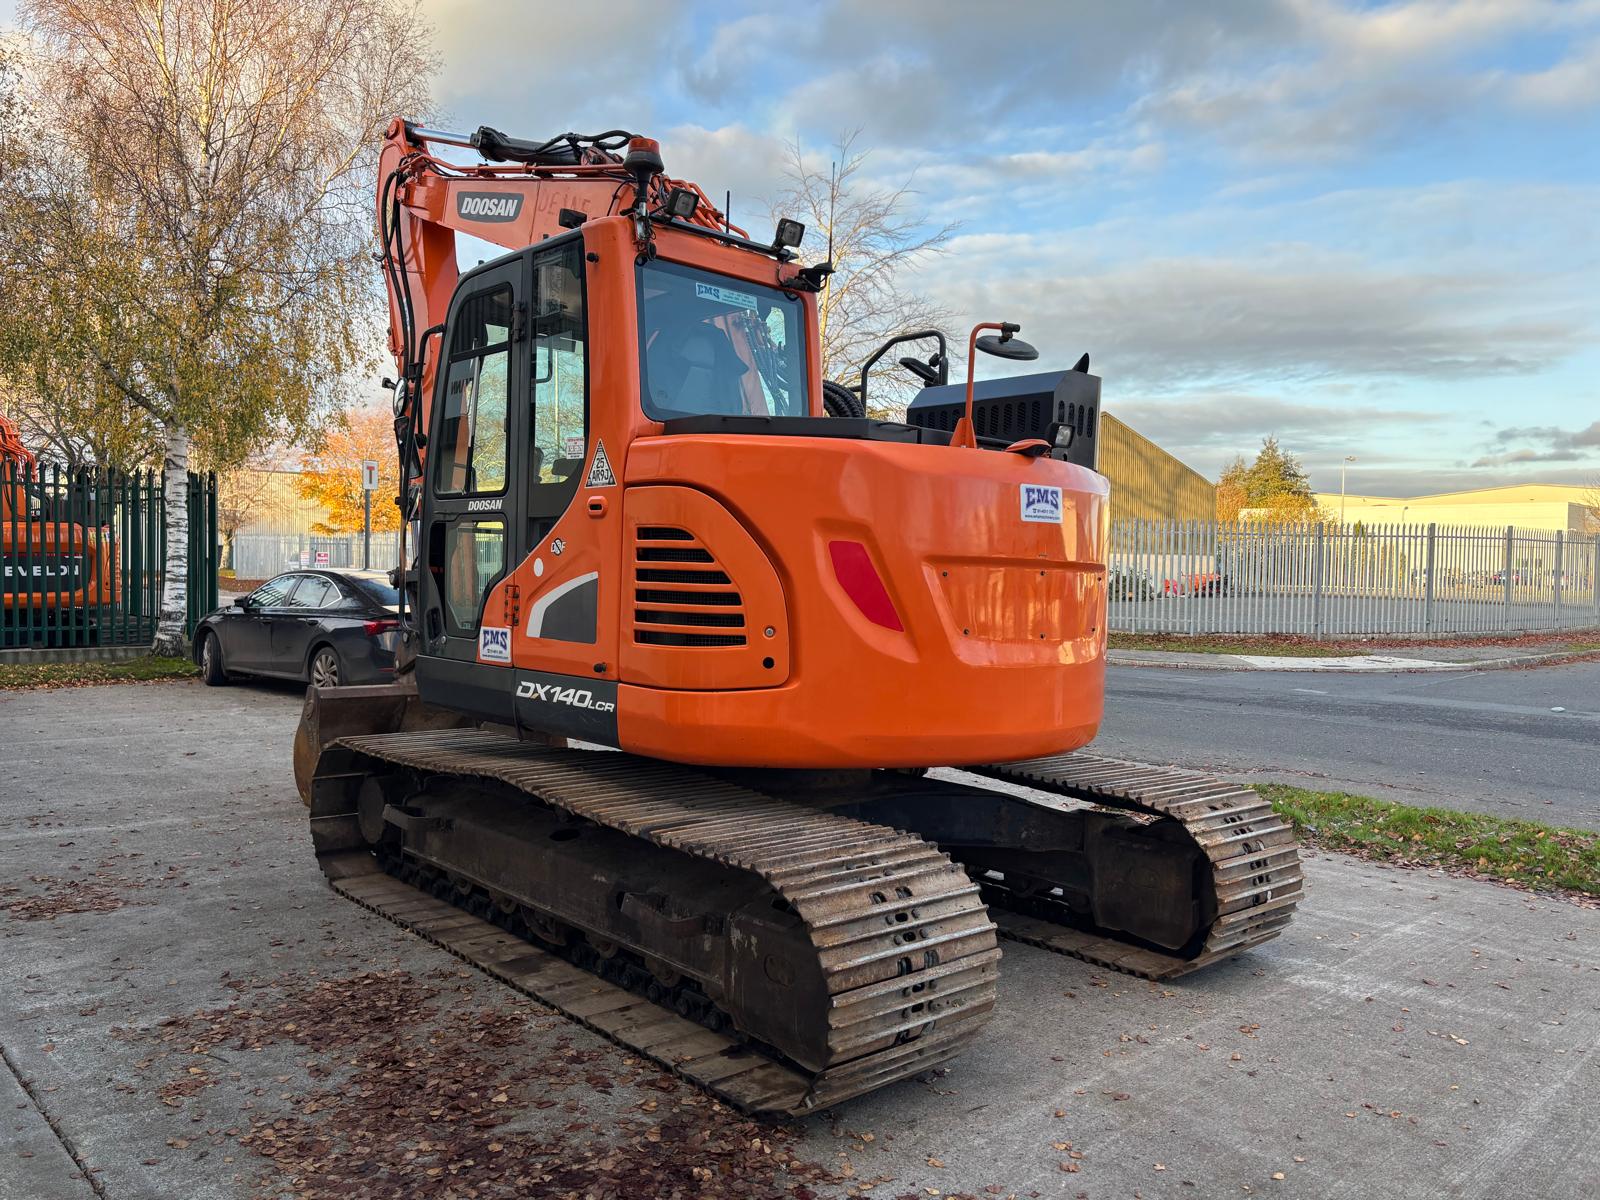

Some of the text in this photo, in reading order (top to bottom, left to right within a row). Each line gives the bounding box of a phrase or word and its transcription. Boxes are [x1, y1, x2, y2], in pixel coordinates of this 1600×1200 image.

[461, 197, 518, 217] DOOSAN
[697, 284, 720, 300] EMS
[596, 457, 605, 469] 25
[468, 499, 503, 511] DOOSAN
[1025, 487, 1059, 511] EMS
[483, 630, 508, 651] EMS
